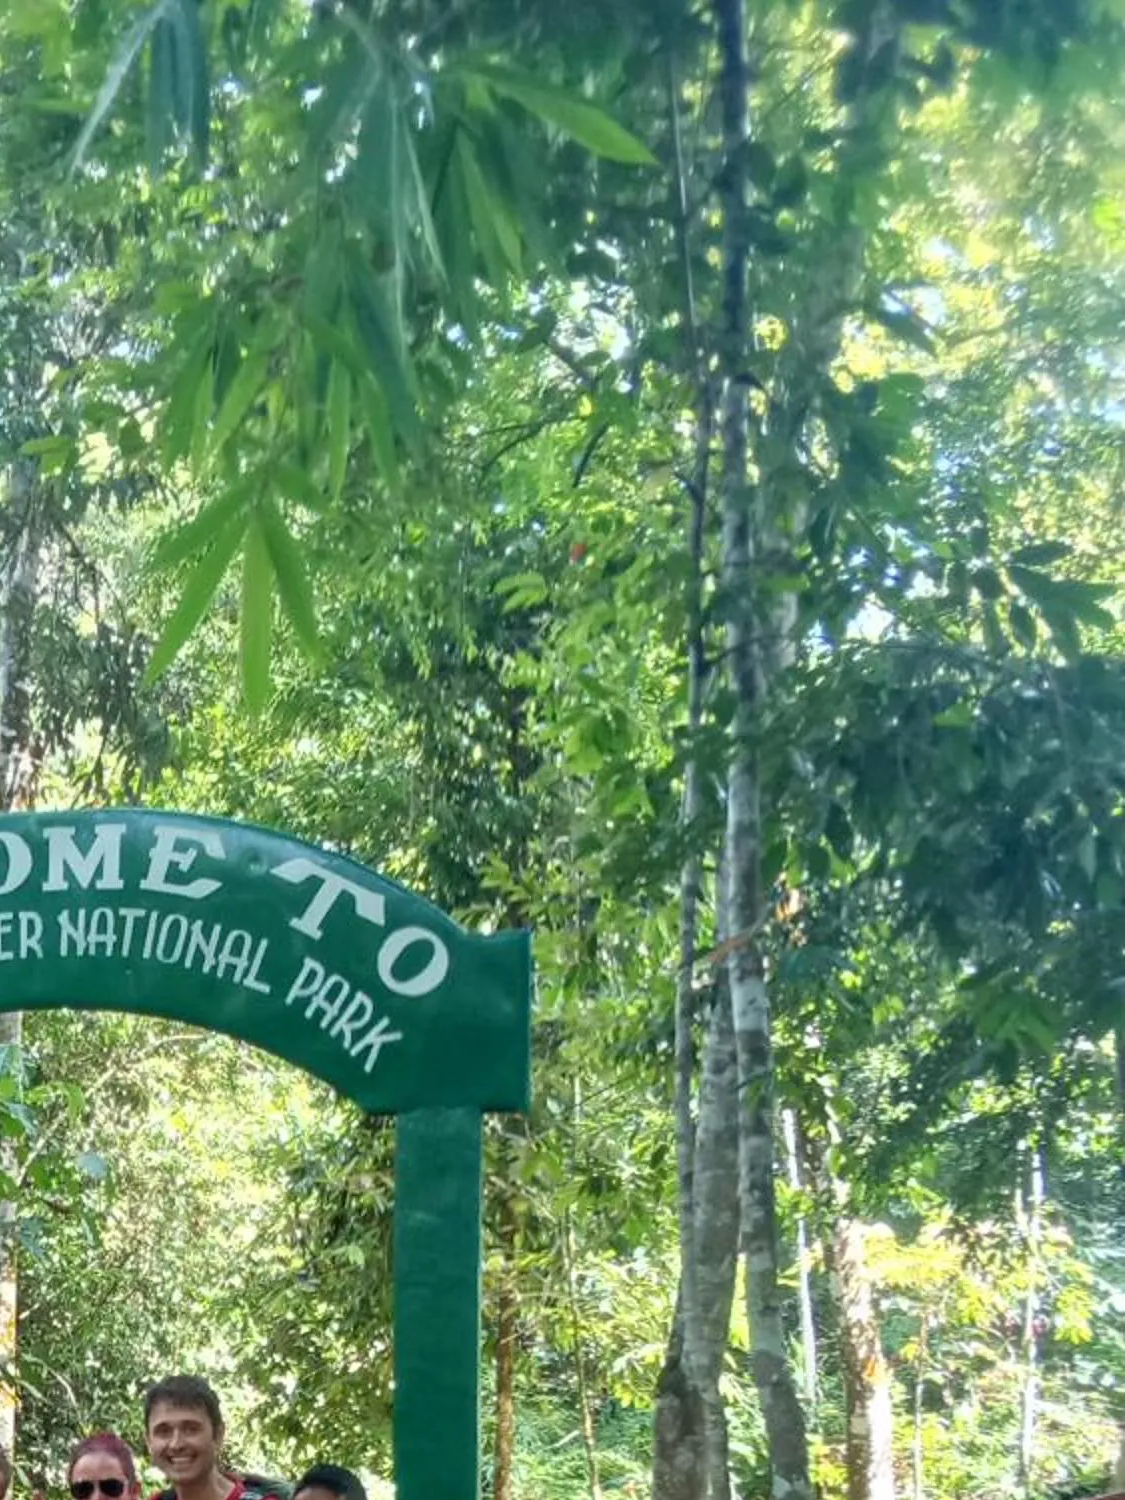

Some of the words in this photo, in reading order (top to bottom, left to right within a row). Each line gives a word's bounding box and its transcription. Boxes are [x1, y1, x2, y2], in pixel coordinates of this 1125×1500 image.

[57, 907, 271, 995] NATIONAL
[285, 956, 403, 1074] PARK
[270, 857, 450, 997] TO
